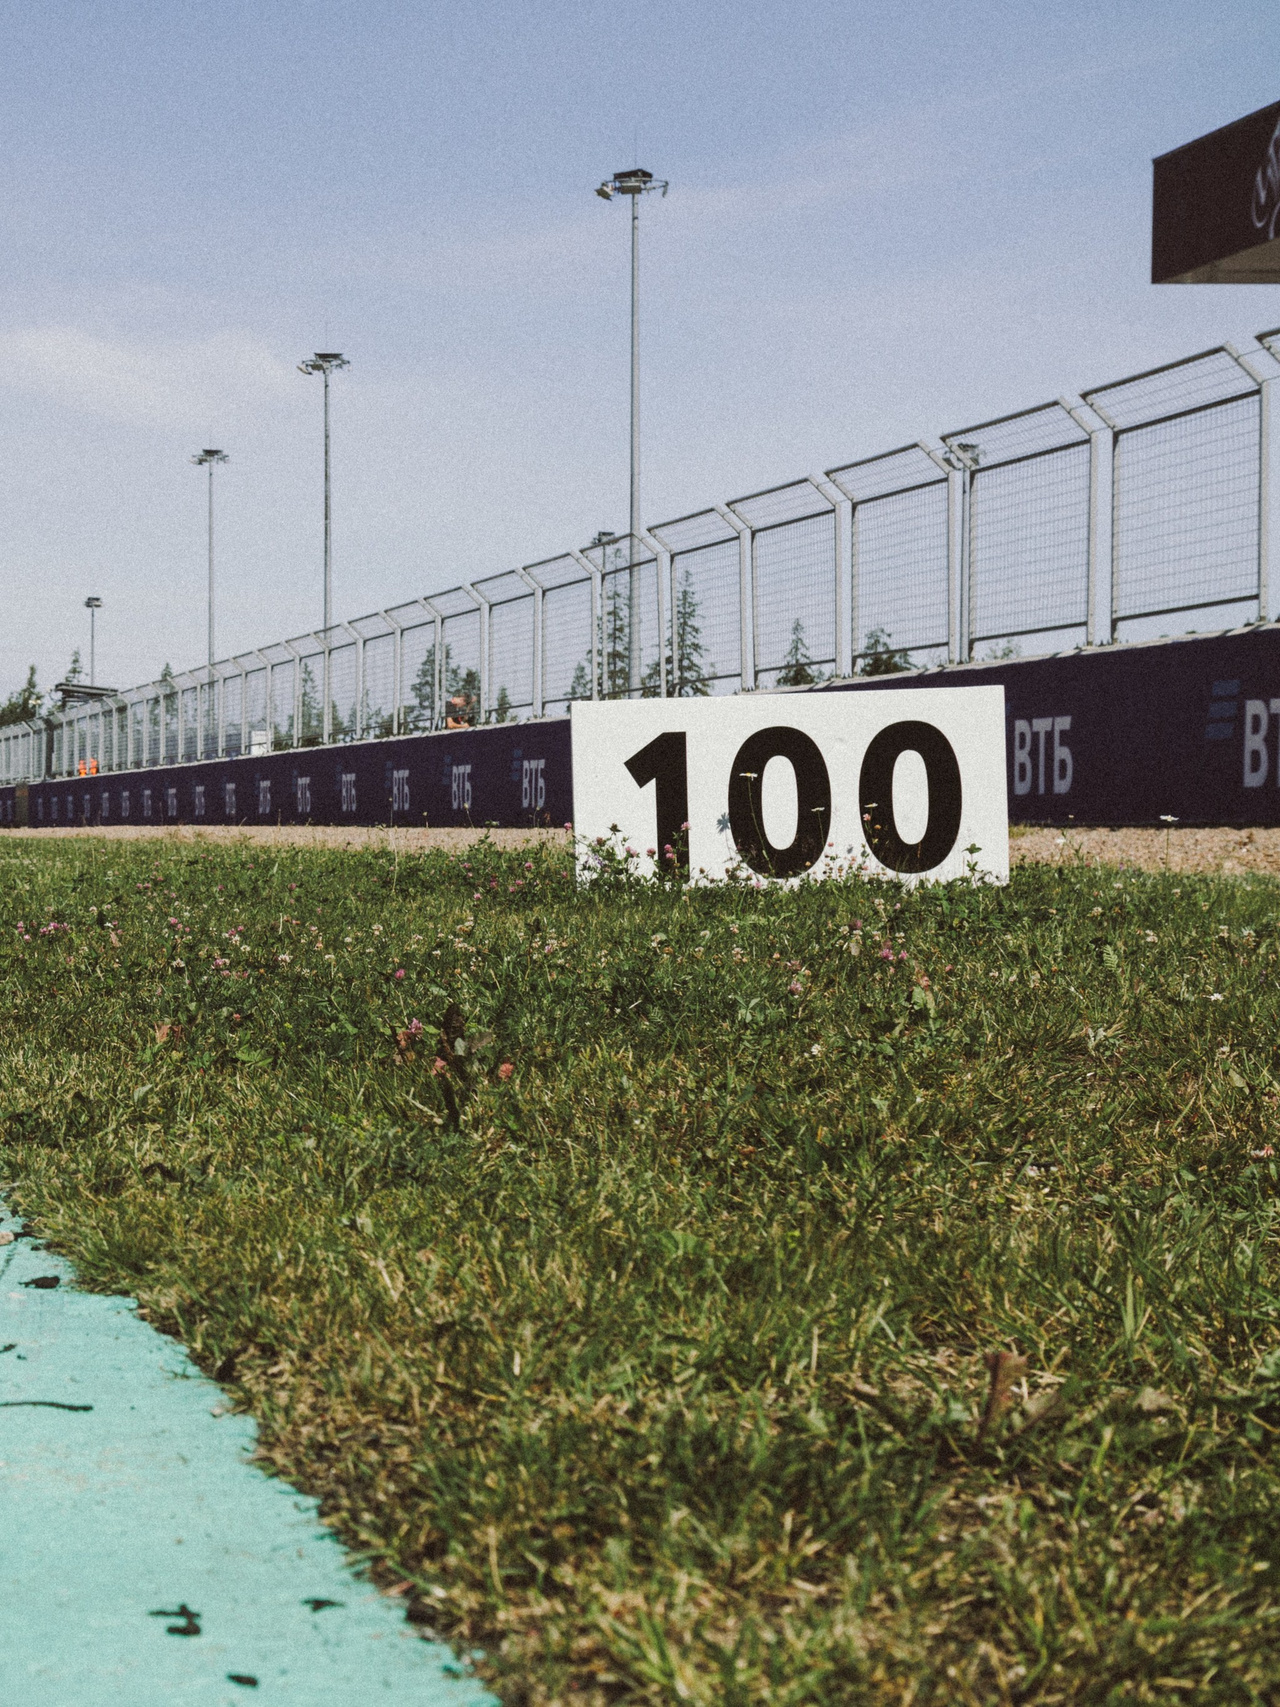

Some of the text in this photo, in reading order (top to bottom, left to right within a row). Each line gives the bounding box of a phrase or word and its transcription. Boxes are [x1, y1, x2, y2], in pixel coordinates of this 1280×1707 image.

[1014, 715, 1074, 796] ВТБ
[393, 769, 410, 811] ВТБ
[452, 765, 472, 810] ВТБ
[522, 759, 546, 809] ВТБ
[624, 719, 963, 882] 100
